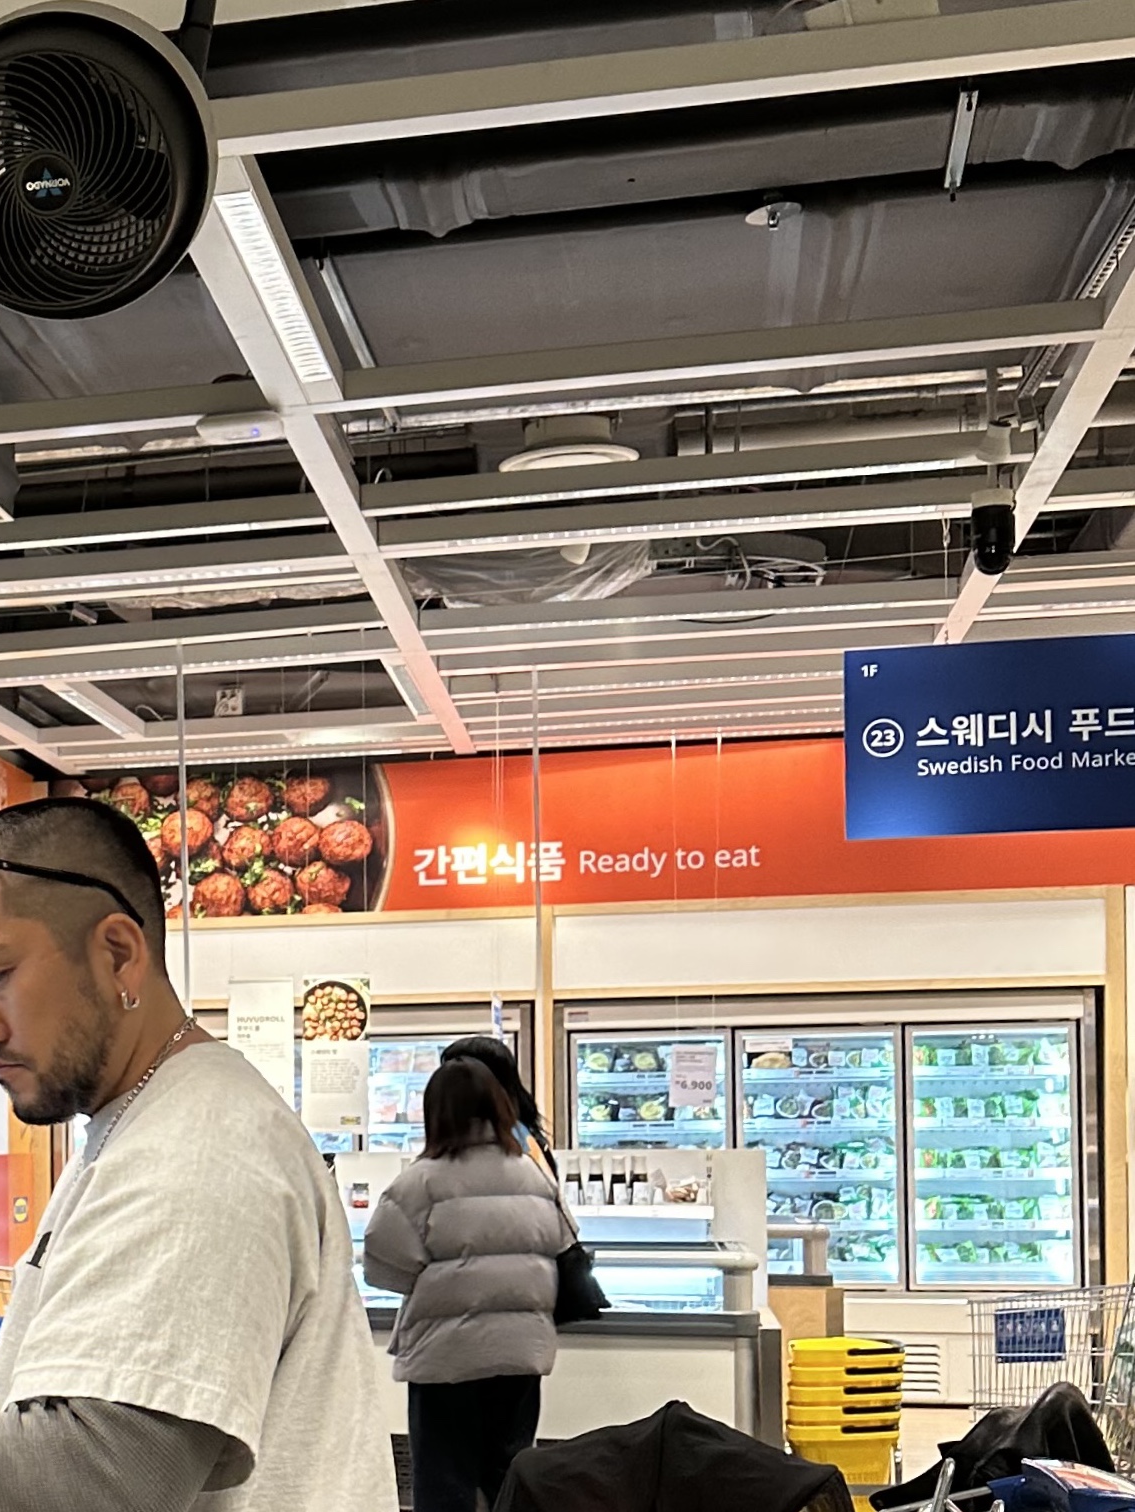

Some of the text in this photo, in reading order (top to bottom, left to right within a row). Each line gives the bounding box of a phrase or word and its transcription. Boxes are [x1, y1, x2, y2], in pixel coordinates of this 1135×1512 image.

[26, 178, 70, 191] VORNADO
[861, 664, 878, 677] 1F
[870, 707, 1135, 747] 23 스웨디시 푸드
[917, 755, 1003, 776] Swedish
[1011, 752, 1063, 772] Food
[413, 841, 761, 886] 간편식품 Ready to eat
